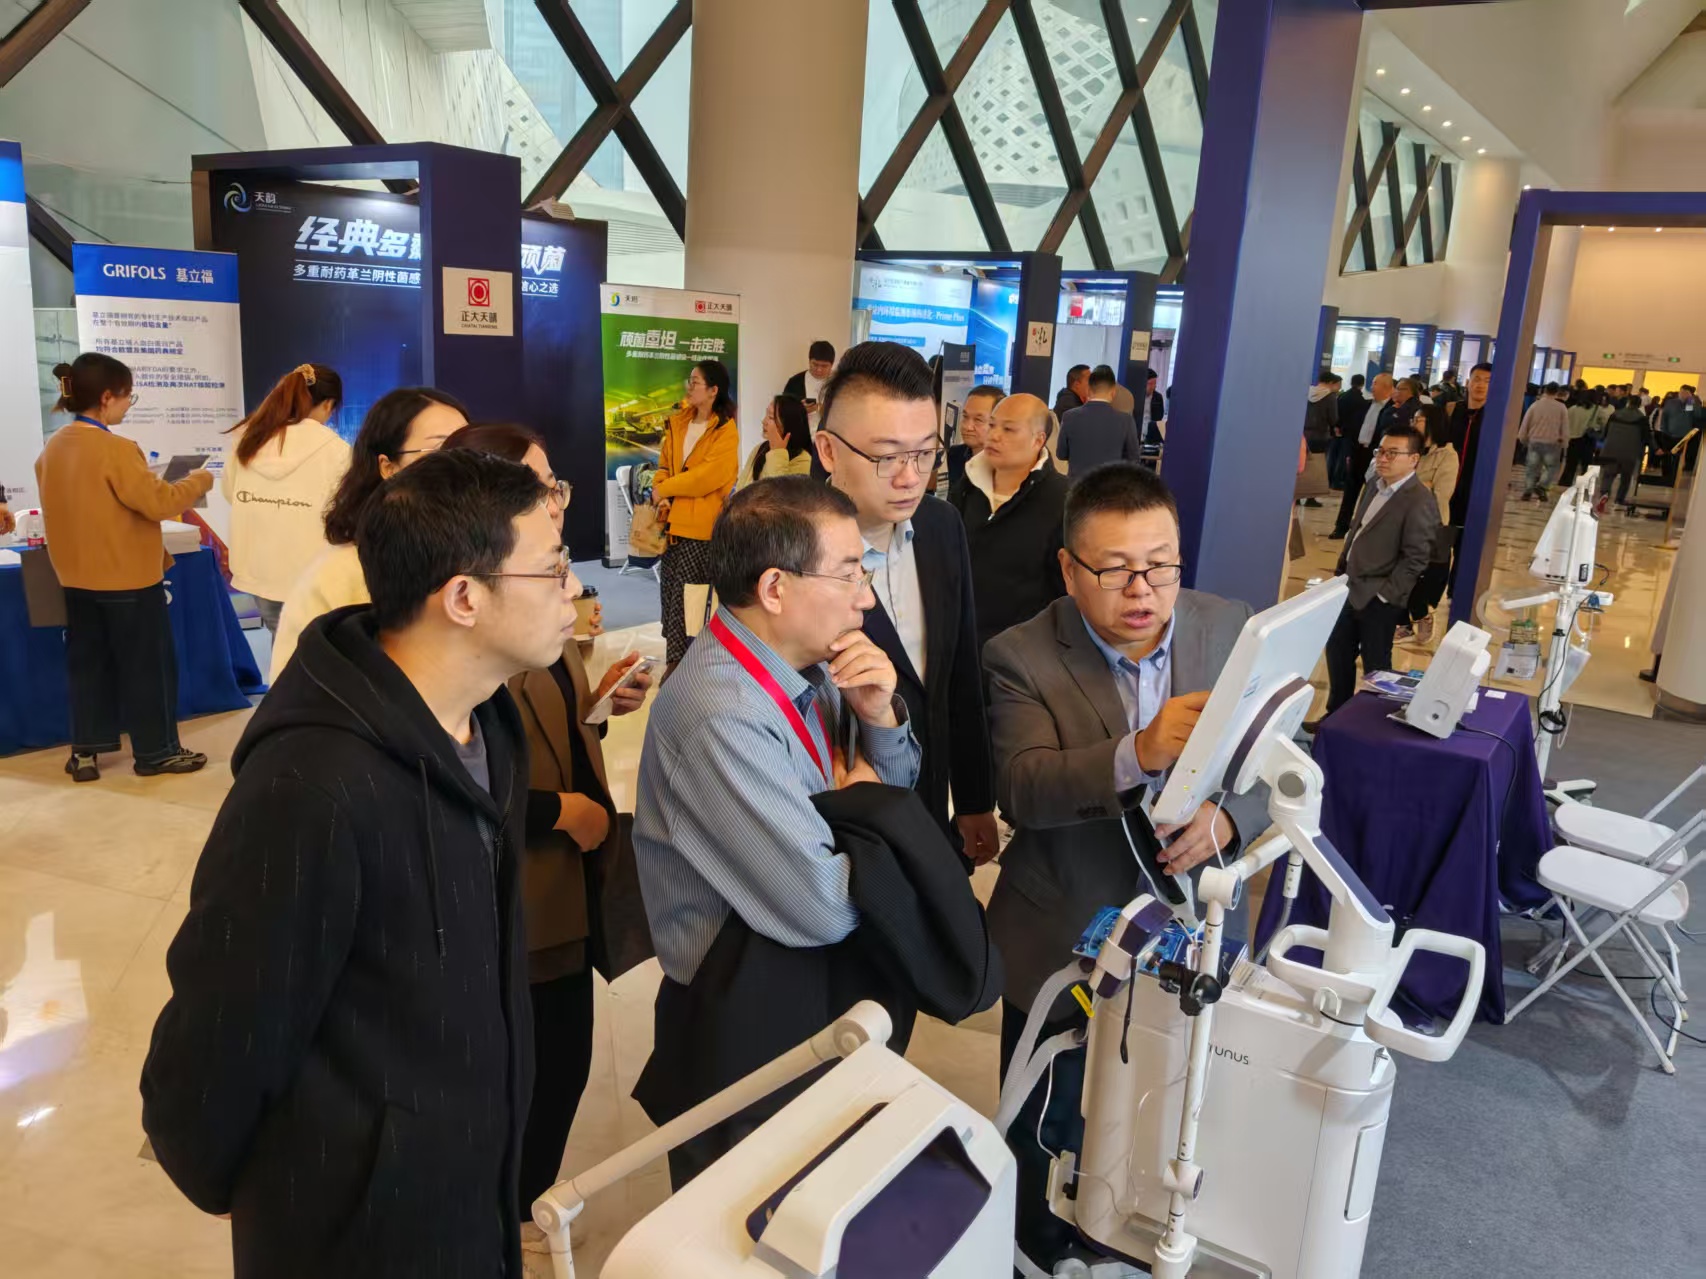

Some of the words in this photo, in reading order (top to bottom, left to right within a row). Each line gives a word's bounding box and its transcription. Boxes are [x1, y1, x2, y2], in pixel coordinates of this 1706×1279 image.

[103, 263, 166, 280] GRIFOLS
[176, 267, 214, 284] 基立福
[294, 263, 421, 285] 多重耐药革兰阴性菌感
[461, 310, 498, 324] 正大天晴
[236, 490, 312, 510] Champion
